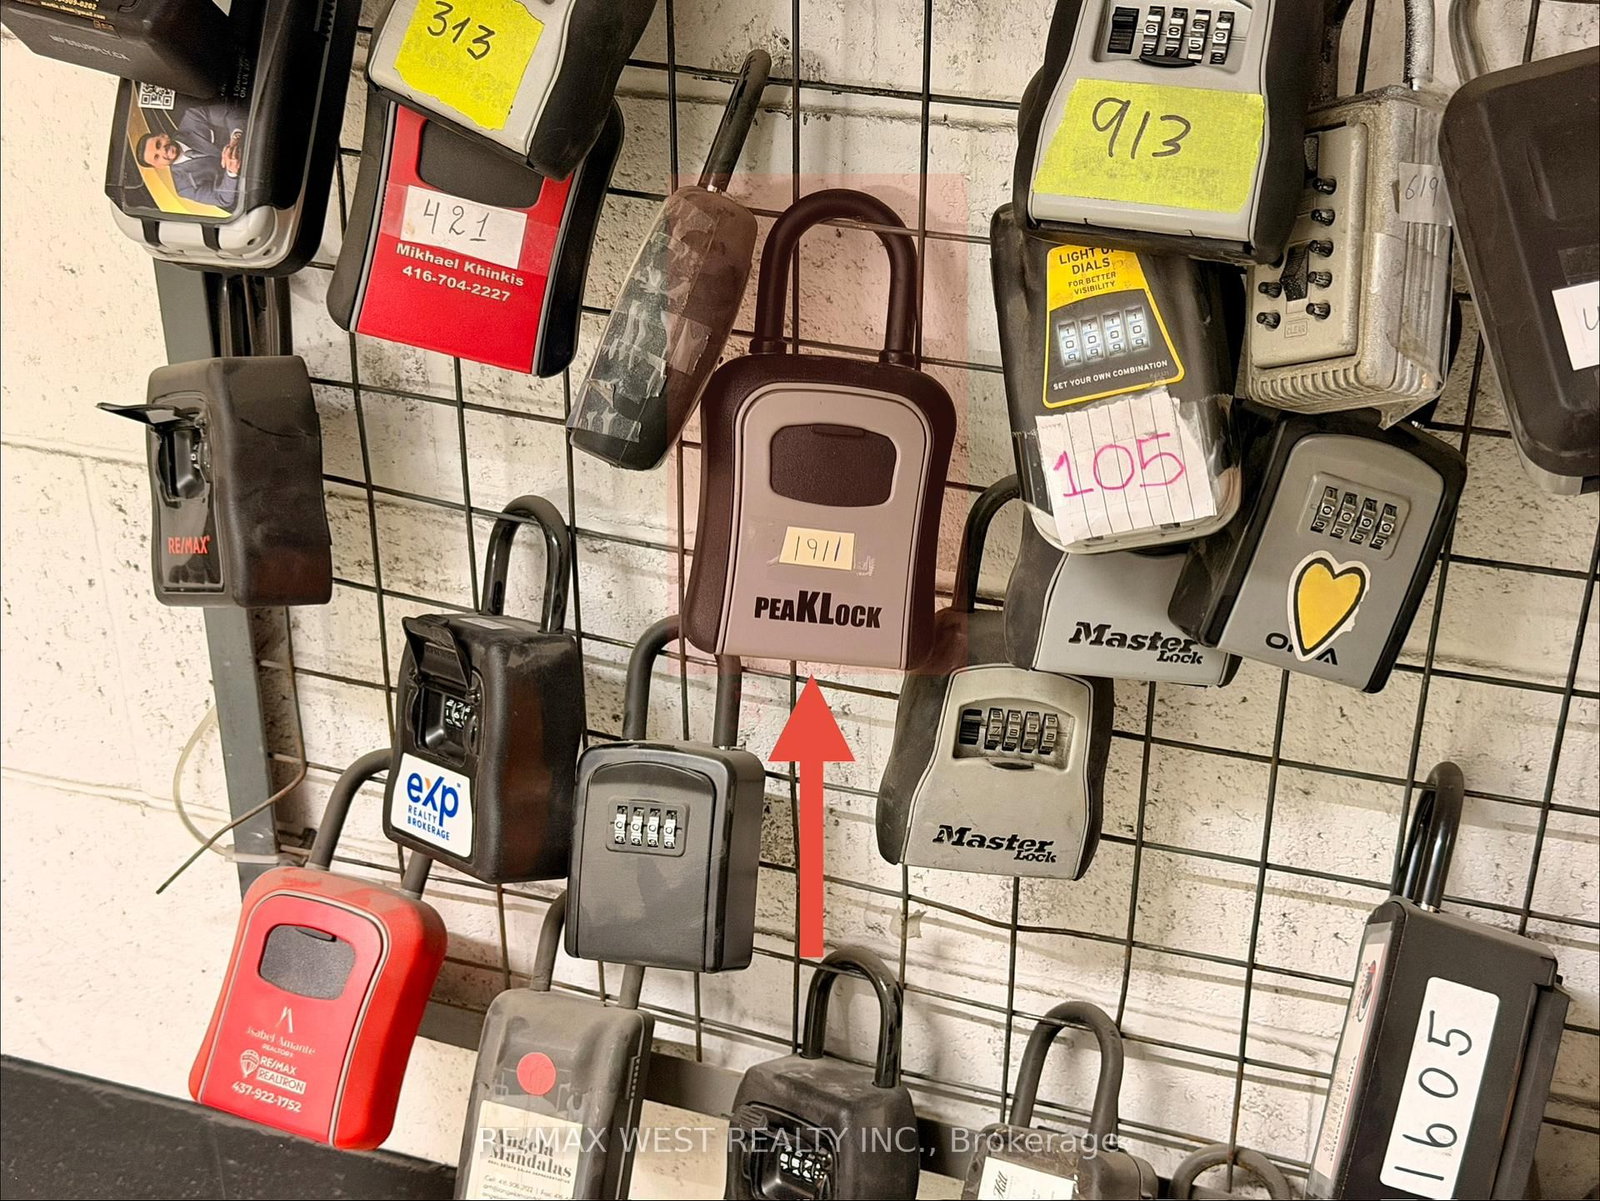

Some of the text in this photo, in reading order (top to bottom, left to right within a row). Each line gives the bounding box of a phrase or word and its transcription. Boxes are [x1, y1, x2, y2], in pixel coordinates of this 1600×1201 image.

[427, 1, 496, 60] 313
[1092, 97, 1191, 160] 913
[1405, 174, 1439, 207] 619
[423, 199, 489, 242] 421
[396, 243, 524, 287] Mikhael Khinkis
[1059, 247, 1115, 265] LIGHT U
[1072, 257, 1111, 275] DIALS
[402, 265, 511, 302] 416-704-2227
[1068, 271, 1116, 288] FOR BETTER
[1074, 280, 1116, 295] VISIBILITY
[1053, 359, 1168, 391] SET YOUR OWN COMBINATION
[1053, 432, 1185, 498] 105
[167, 536, 208, 554] RE/MAX
[794, 535, 842, 562] 1911
[1068, 621, 1198, 653] Master
[1156, 650, 1204, 665] Lock
[407, 815, 450, 841] BROKERAGE
[408, 804, 437, 824] REALTY
[932, 824, 1055, 852] Master
[1013, 849, 1057, 863] Lock
[247, 1026, 316, 1055] Isabel Amante
[260, 1056, 298, 1076] RE/MAX
[258, 1069, 305, 1092] REALTRON
[231, 1081, 302, 1113] 437-922-1752
[1394, 1010, 1473, 1181] 1605
[493, 1129, 553, 1157] Angela
[489, 1147, 571, 1178] Mandalas
